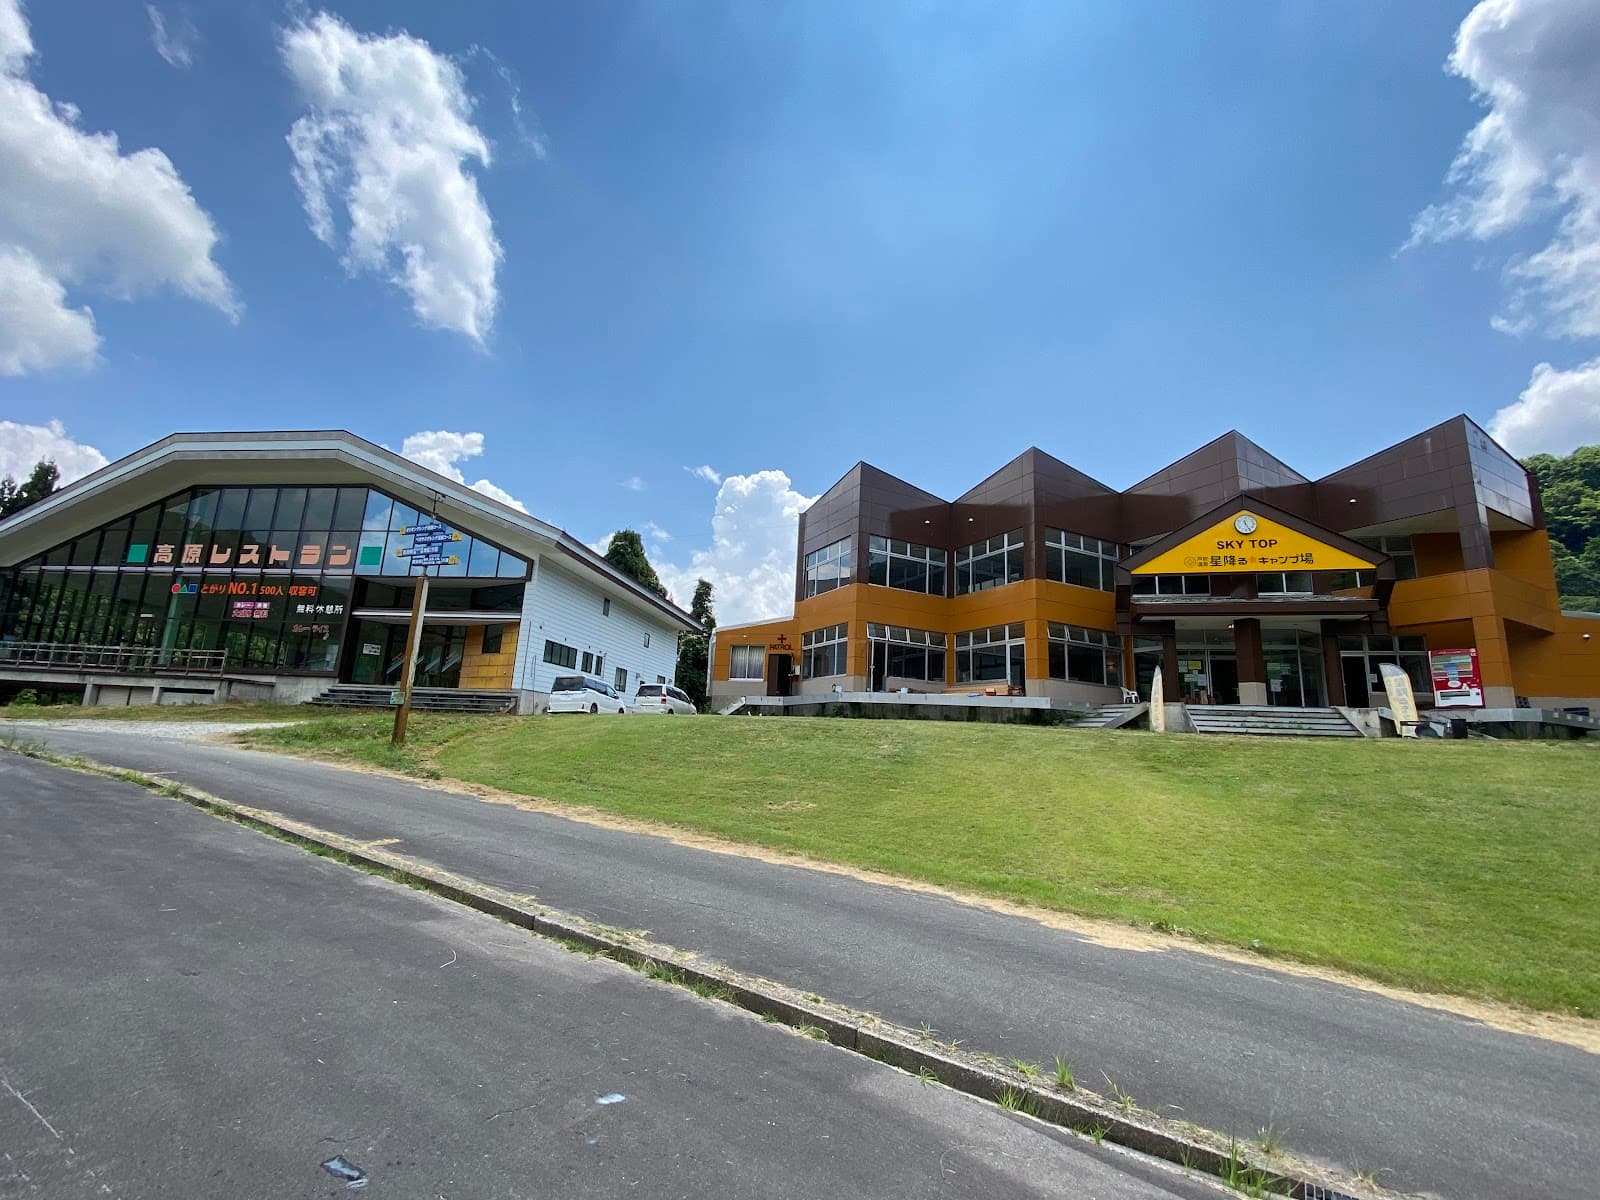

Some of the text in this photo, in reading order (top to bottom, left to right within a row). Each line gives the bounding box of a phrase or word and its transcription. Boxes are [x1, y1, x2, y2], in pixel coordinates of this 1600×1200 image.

[1216, 539, 1278, 550] SKY TOP
[153, 544, 352, 565] 高原レストラン
[227, 581, 258, 595] NO.1
[295, 604, 344, 615] 無料休憩所
